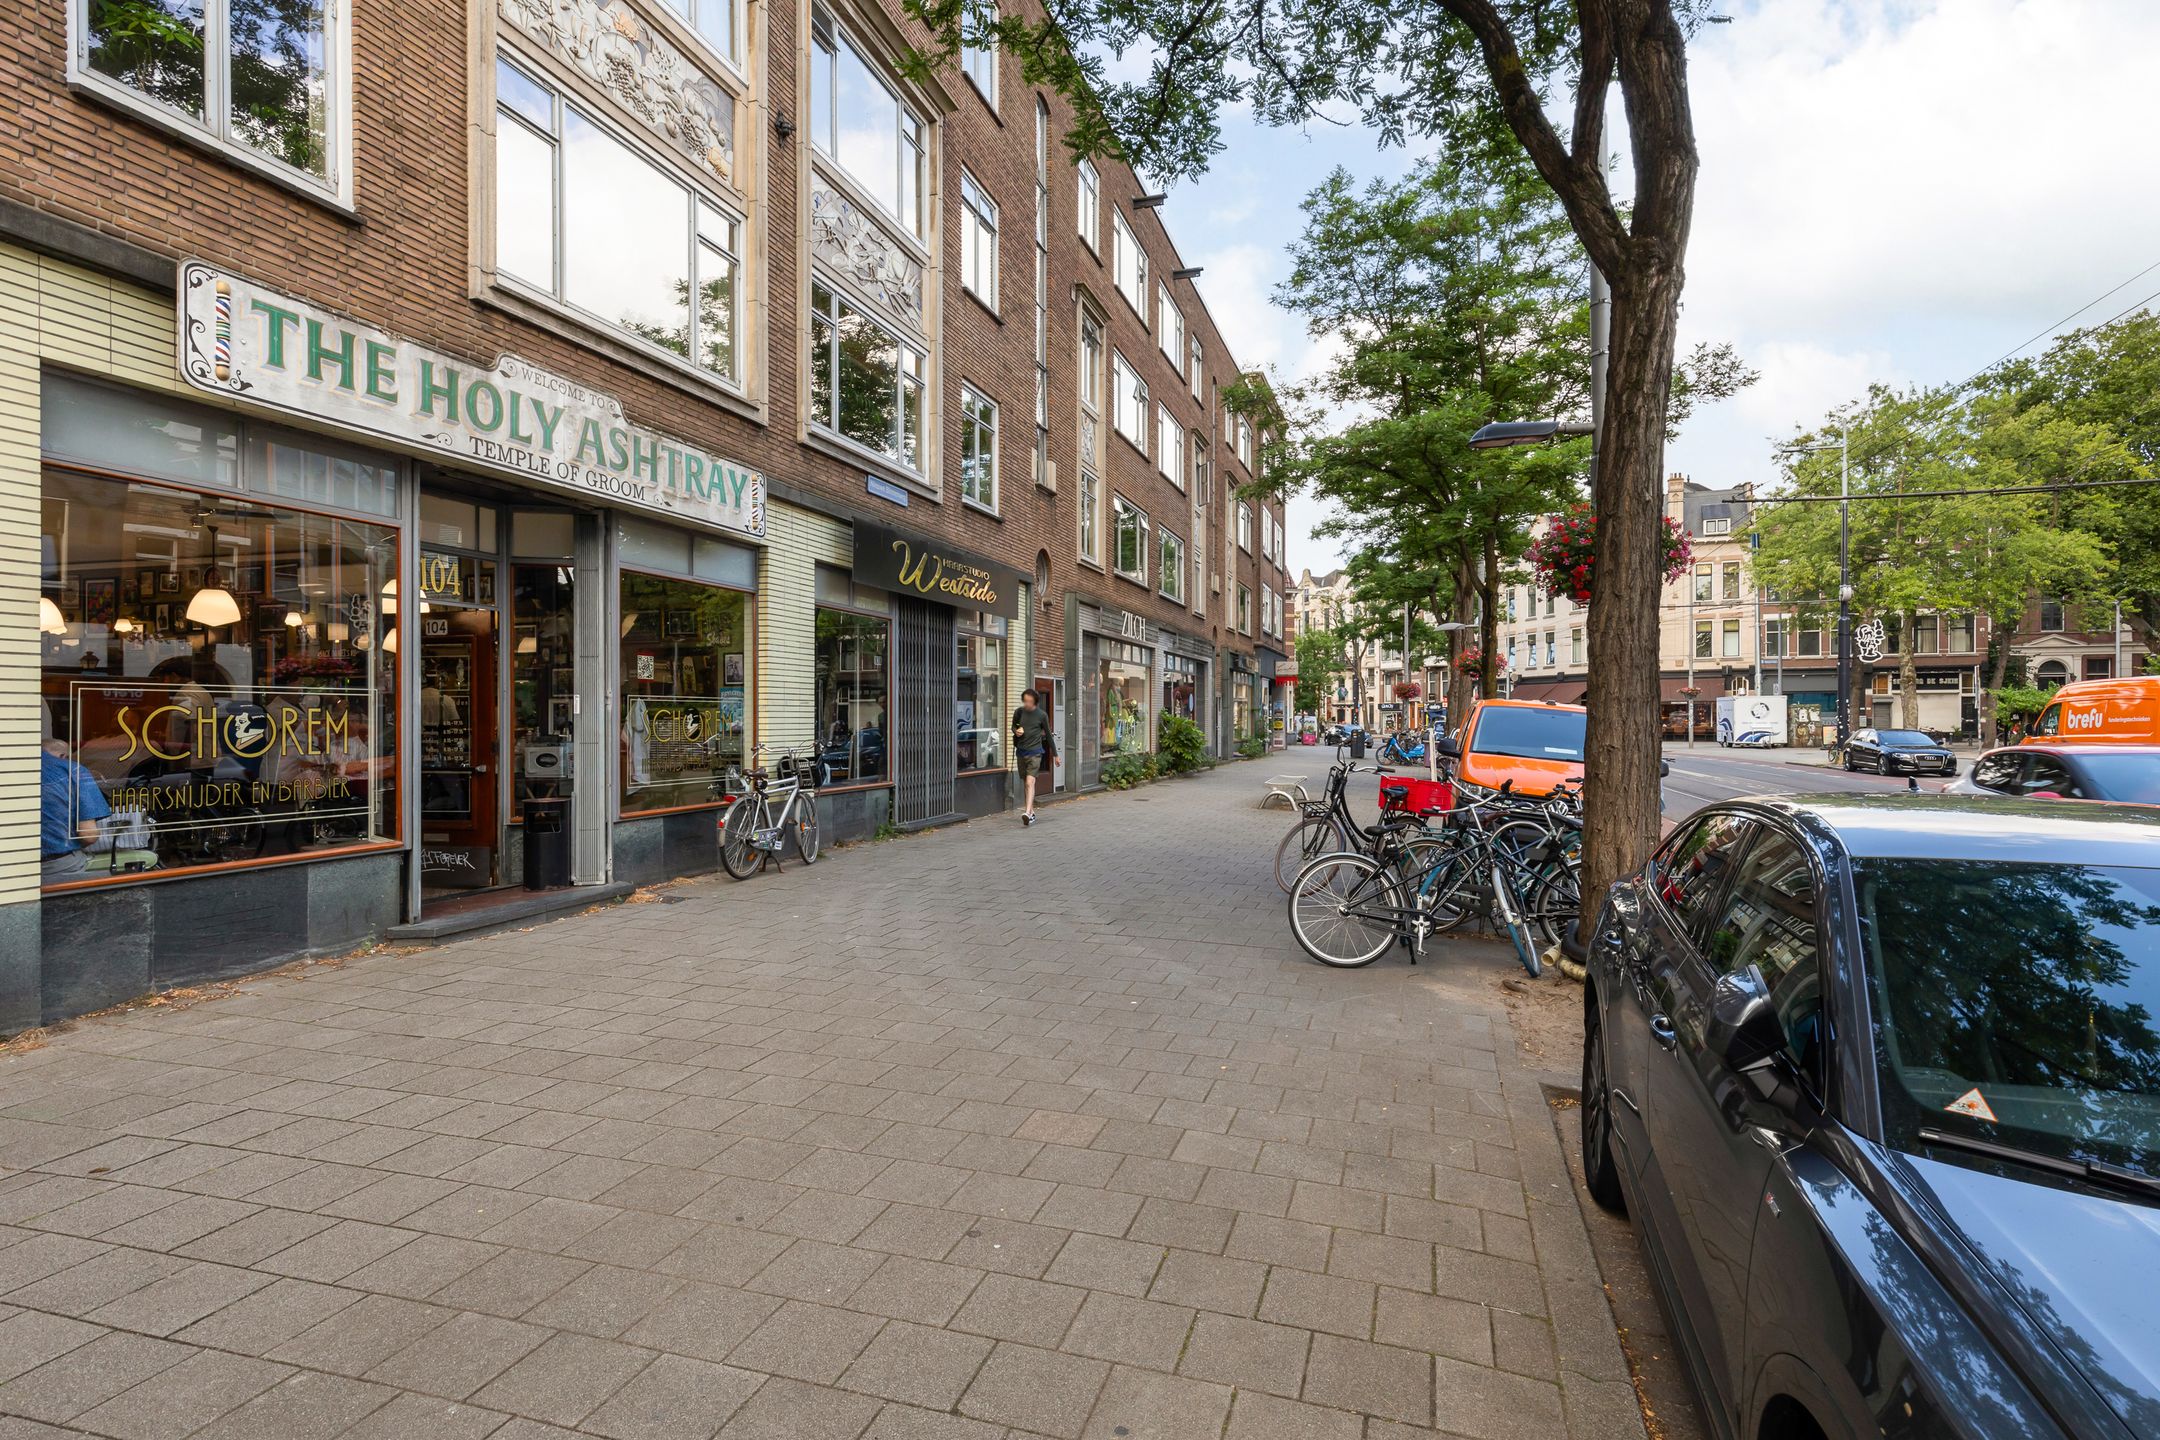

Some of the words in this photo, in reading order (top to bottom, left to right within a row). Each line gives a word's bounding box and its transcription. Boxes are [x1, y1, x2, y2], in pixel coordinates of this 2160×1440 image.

[250, 298, 399, 404] THE
[418, 357, 566, 453] HOLY
[575, 419, 748, 511] ASHTRAY
[520, 365, 580, 402] WELCOME
[581, 393, 606, 410] TO
[469, 435, 552, 476] TEMPLE
[556, 462, 580, 481] OF
[585, 468, 647, 502] GROOM
[420, 557, 461, 596] 104
[892, 540, 998, 604] Westside
[943, 557, 990, 580] HAARSTUDIO
[426, 621, 447, 634] 104
[1122, 610, 1146, 642] ZILCH
[116, 704, 349, 762] SCHOREM
[643, 708, 734, 744] SCHOREM
[2067, 708, 2103, 729] brefu
[111, 781, 242, 813] HAARSNIJDER
[252, 780, 270, 804] EN
[278, 776, 351, 803] BARBIER
